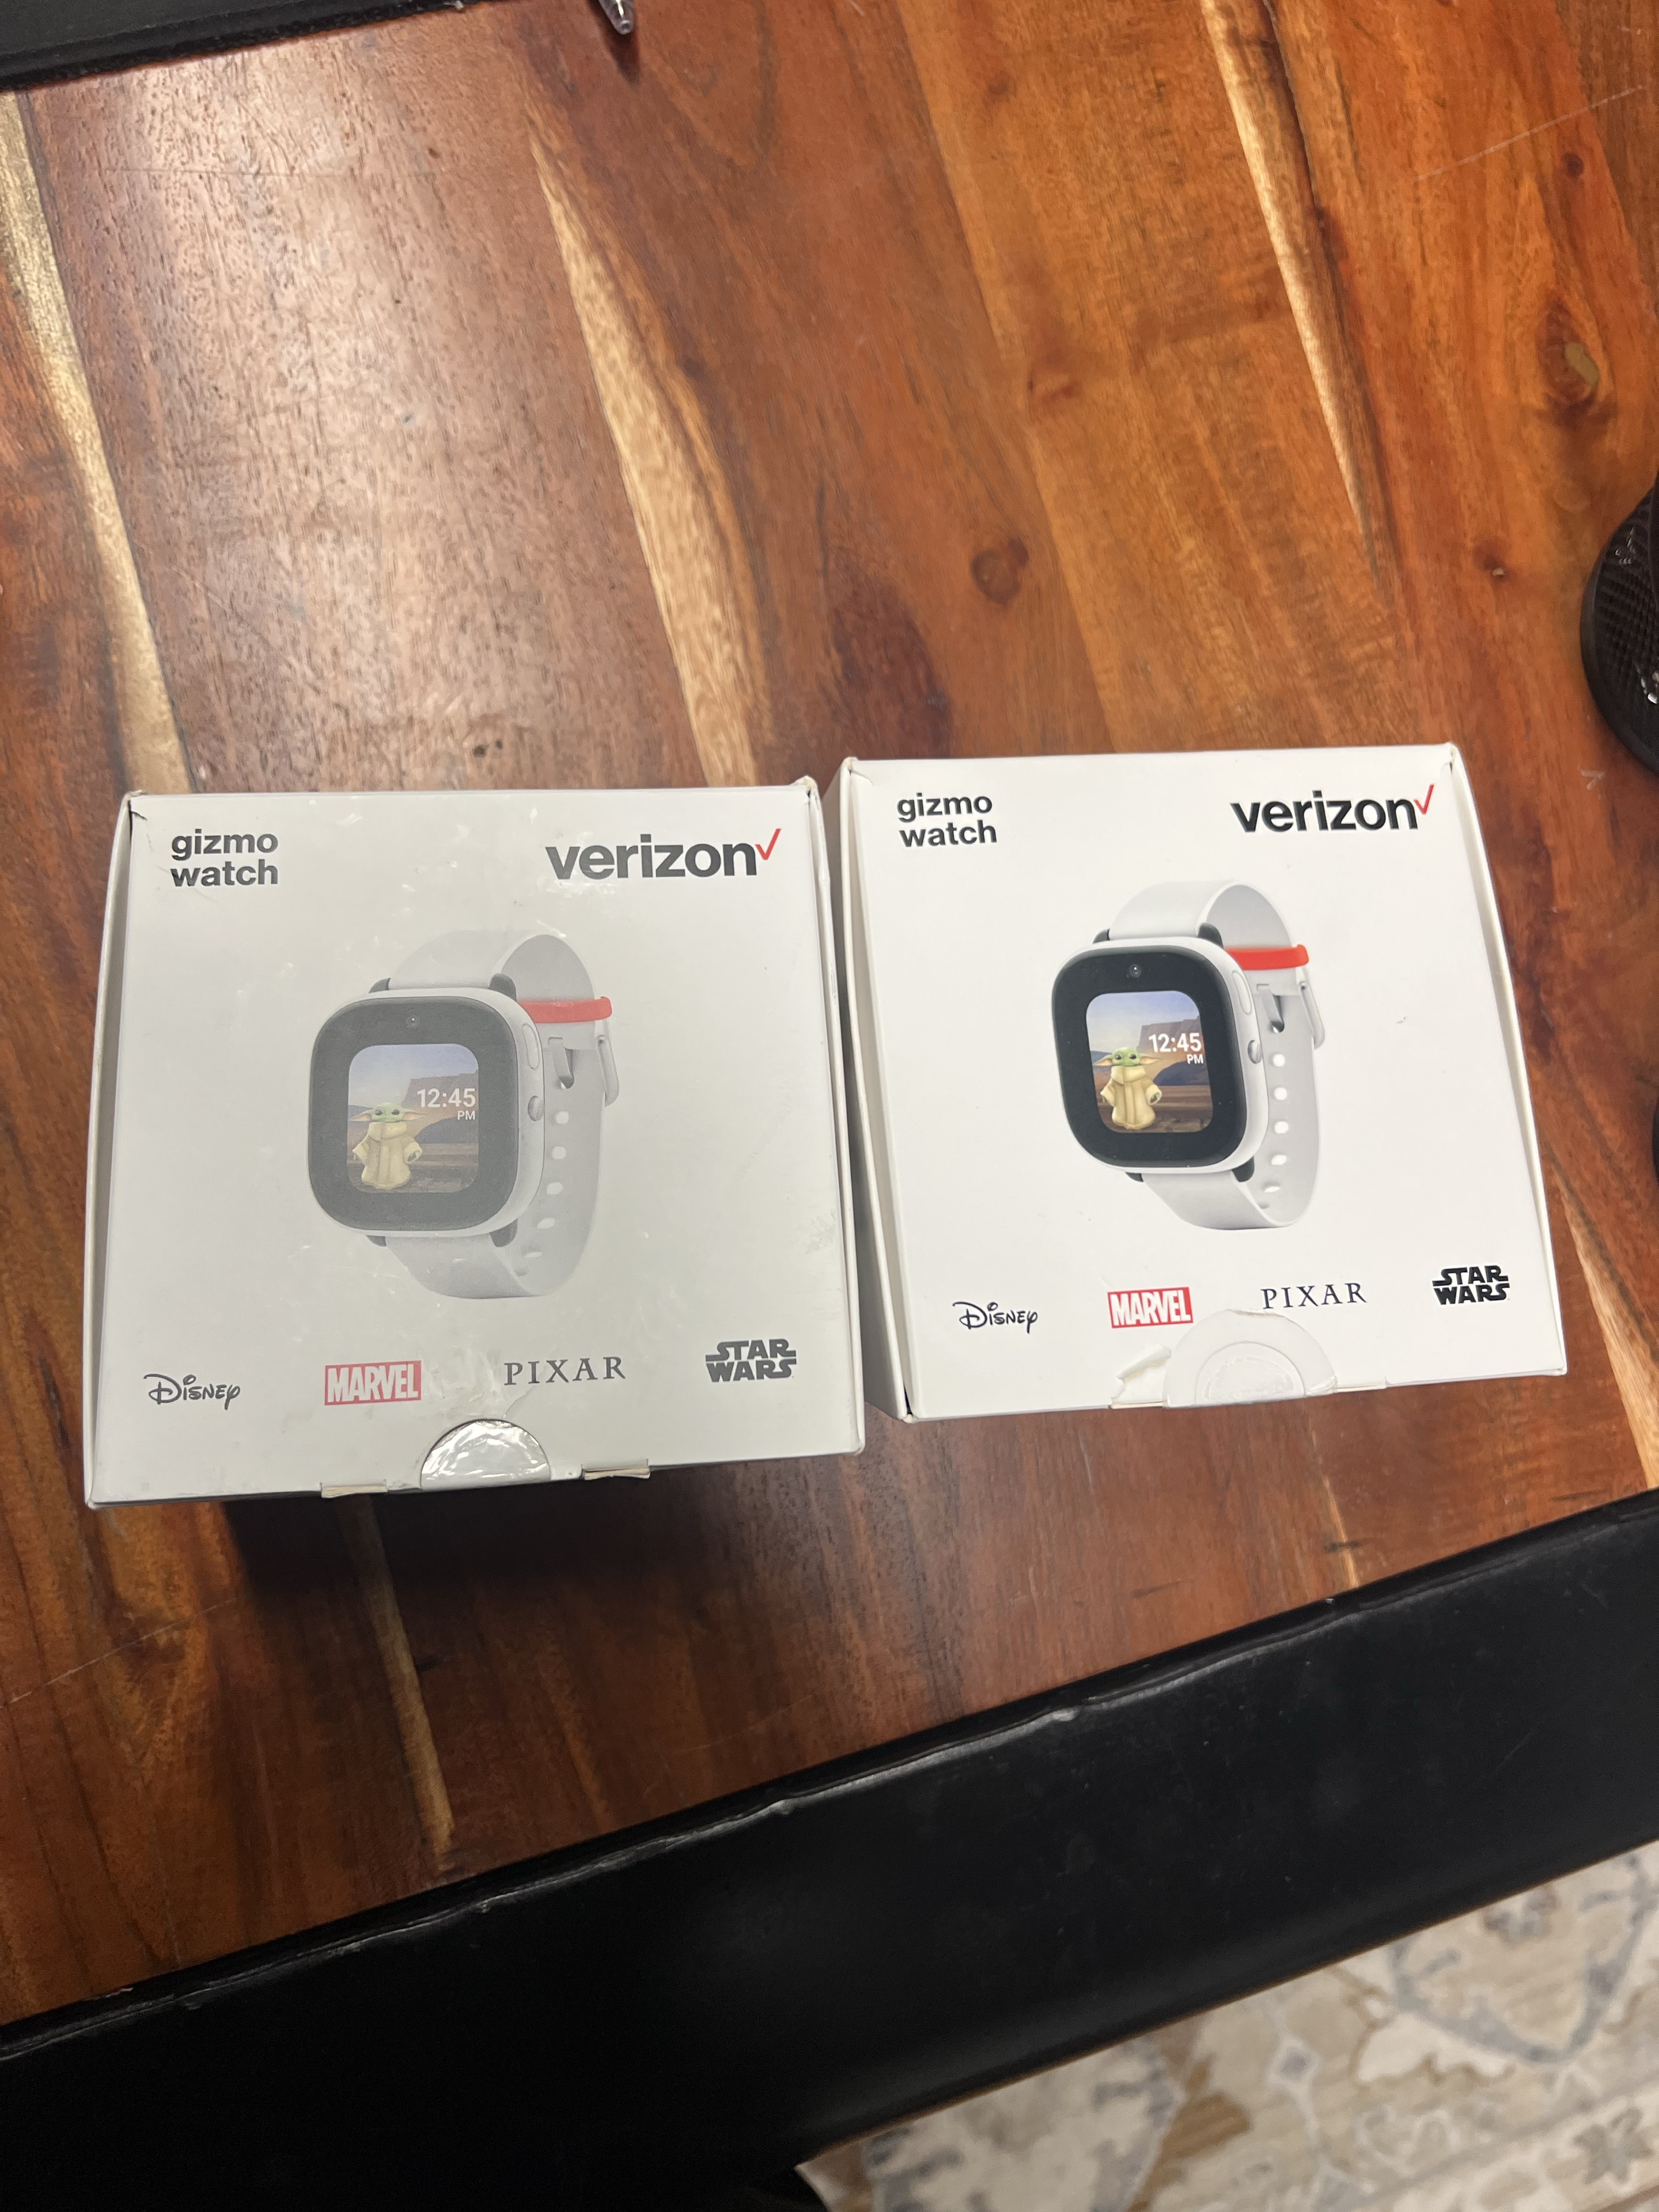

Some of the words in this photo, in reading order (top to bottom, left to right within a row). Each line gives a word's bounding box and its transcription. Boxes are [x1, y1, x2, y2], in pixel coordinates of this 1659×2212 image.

[897, 793, 993, 823] gizmo
[1230, 790, 1418, 832] verizon
[171, 828, 279, 861] gizmo
[899, 820, 997, 847] watch
[545, 834, 757, 880] verizon
[171, 859, 278, 887] watch
[1148, 1032, 1202, 1052] 12:45
[1187, 1054, 1204, 1064] PM
[416, 1088, 476, 1108] 12:45
[456, 1110, 476, 1120] PM
[1432, 1265, 1509, 1286] STAR
[1261, 1282, 1367, 1309] PIXAR
[1434, 1283, 1510, 1305] WARS
[1109, 1289, 1191, 1327] MARVEL
[706, 1339, 797, 1361] STAR
[328, 1363, 419, 1403] MARVEL
[504, 1356, 626, 1386] PIXAR
[706, 1359, 797, 1382] WARS
